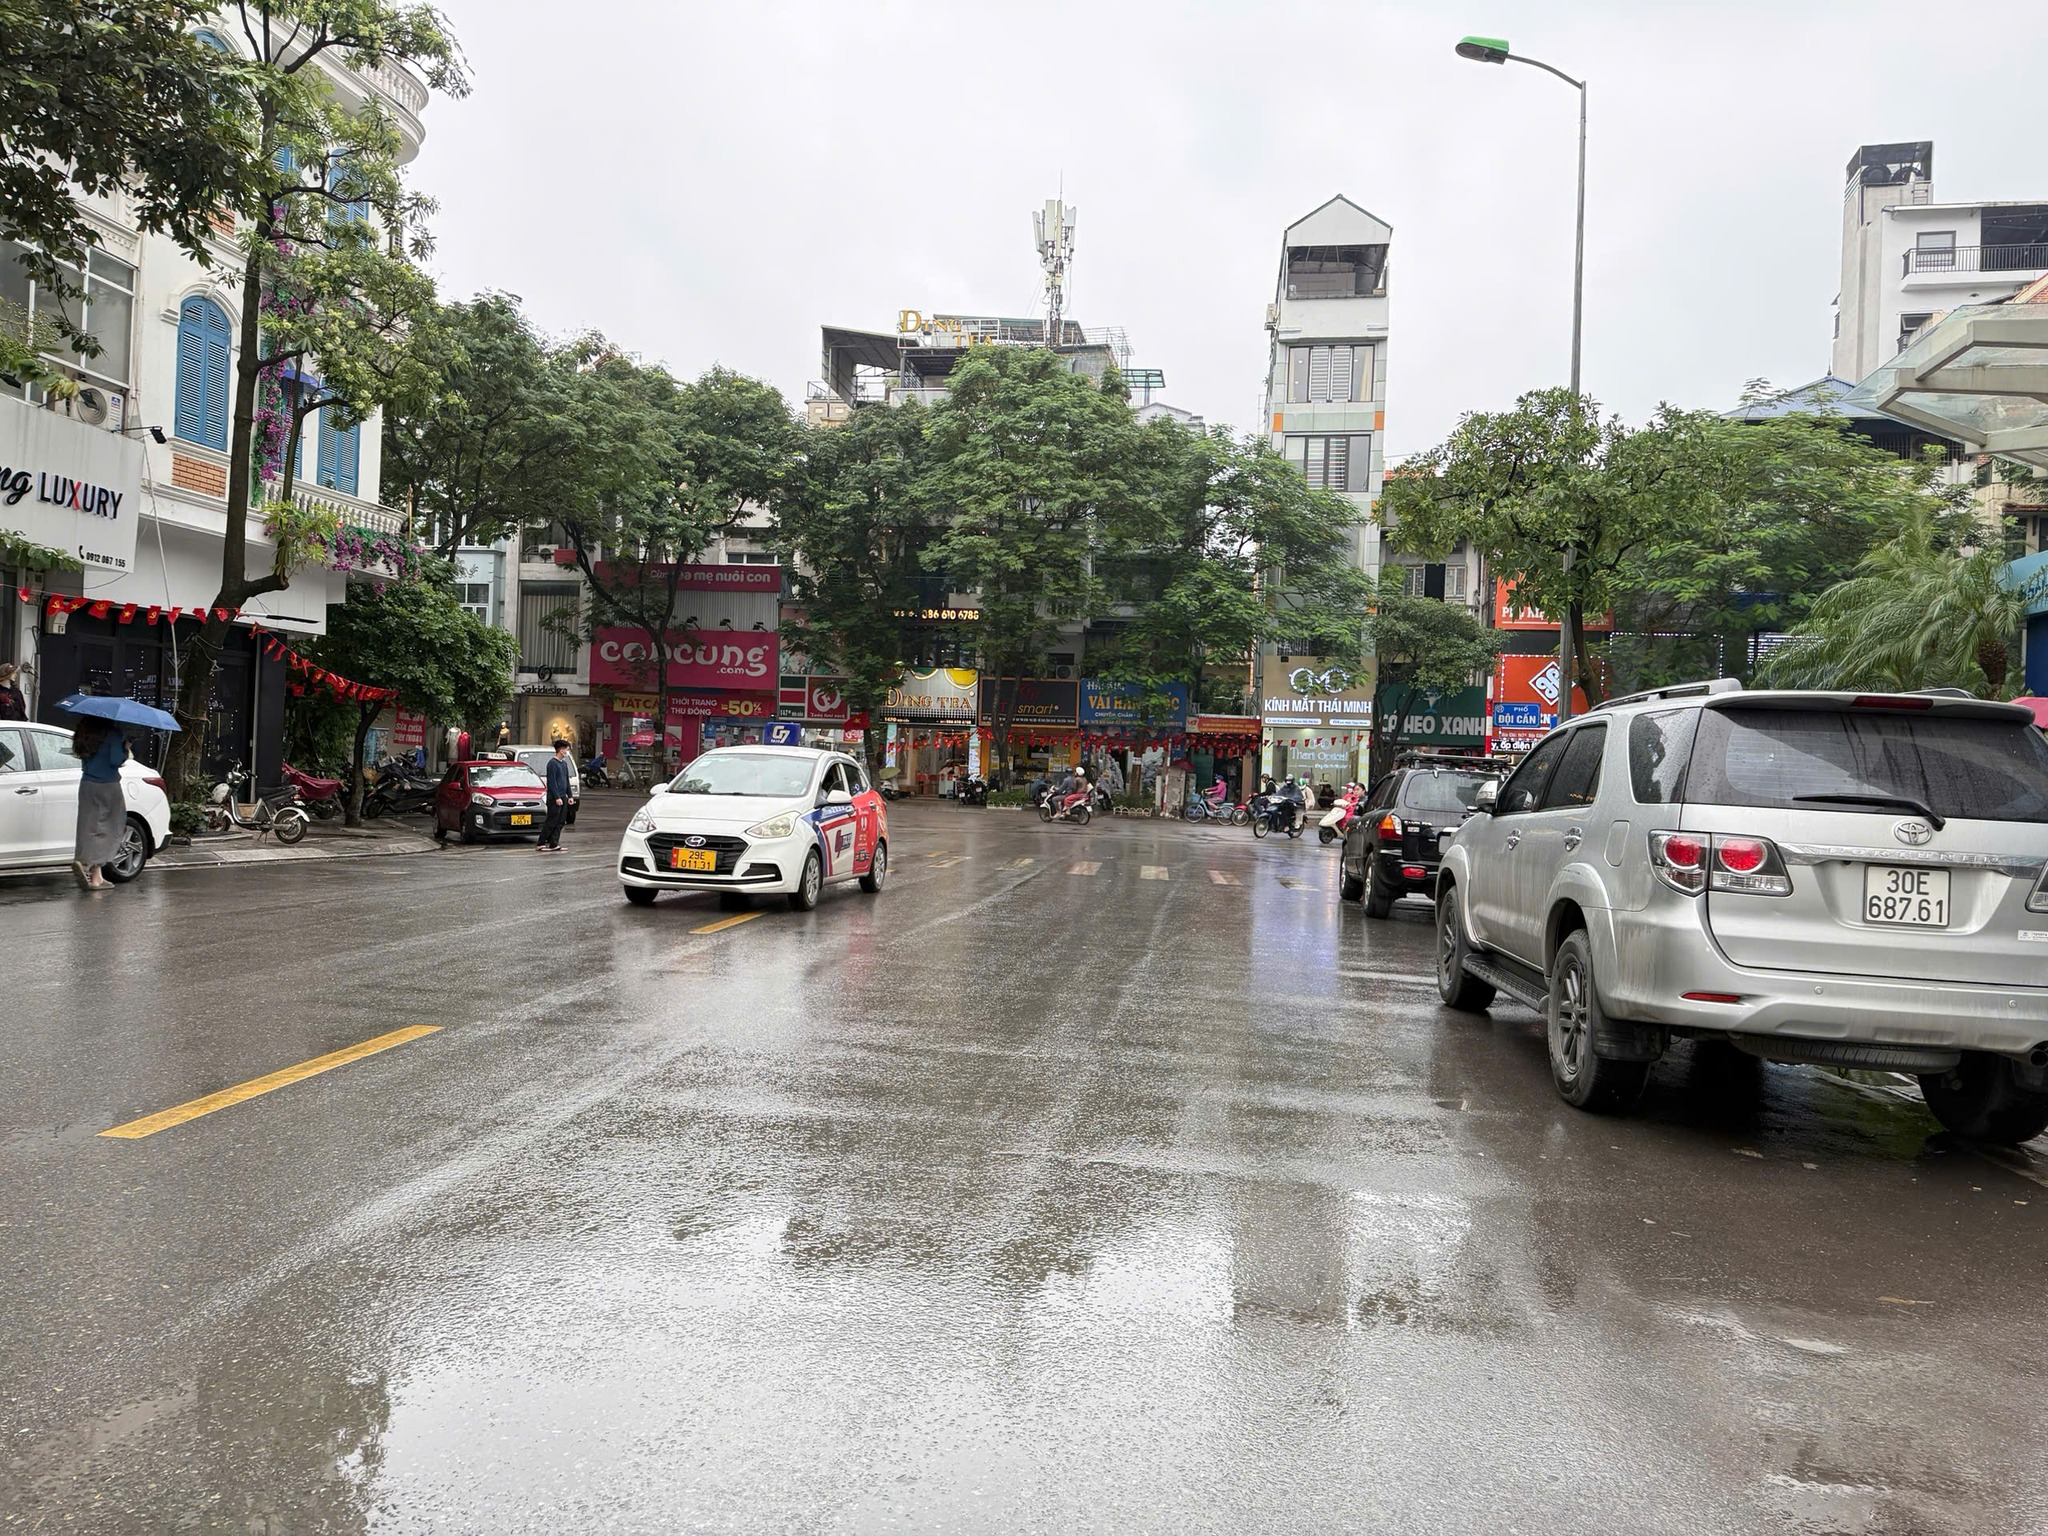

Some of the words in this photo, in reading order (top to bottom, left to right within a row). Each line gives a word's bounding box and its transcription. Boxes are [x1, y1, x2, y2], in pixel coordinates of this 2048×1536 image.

[39, 471, 123, 519] LUXURY
[86, 551, 101, 563] 0912
[102, 555, 113, 565] 067
[115, 558, 126, 568] 155
[694, 571, 713, 584] mẹ
[716, 570, 744, 582] nuôi
[747, 573, 771, 583] con
[716, 666, 745, 674] .com
[671, 697, 690, 705] THỜI
[691, 698, 717, 707] TRANG
[885, 687, 933, 708] DING
[937, 695, 973, 708] TEA
[1264, 696, 1290, 712] KÍNH
[1291, 694, 1316, 712] MẮT
[1317, 697, 1342, 713] THÁI
[1343, 700, 1372, 714] MINH
[671, 707, 686, 715] THU
[687, 706, 712, 716] ĐÔNG
[1498, 713, 1514, 725] ĐỘI
[1516, 711, 1537, 724] CẤN
[1403, 715, 1436, 734] HEO
[1440, 716, 1486, 736] XANH
[772, 725, 791, 743] G7
[689, 850, 705, 860] 29E
[1828, 848, 2000, 864] FORTUNER
[681, 860, 711, 870] 011.31
[1886, 870, 1930, 895] 30E
[1868, 895, 1943, 923] 687.61
